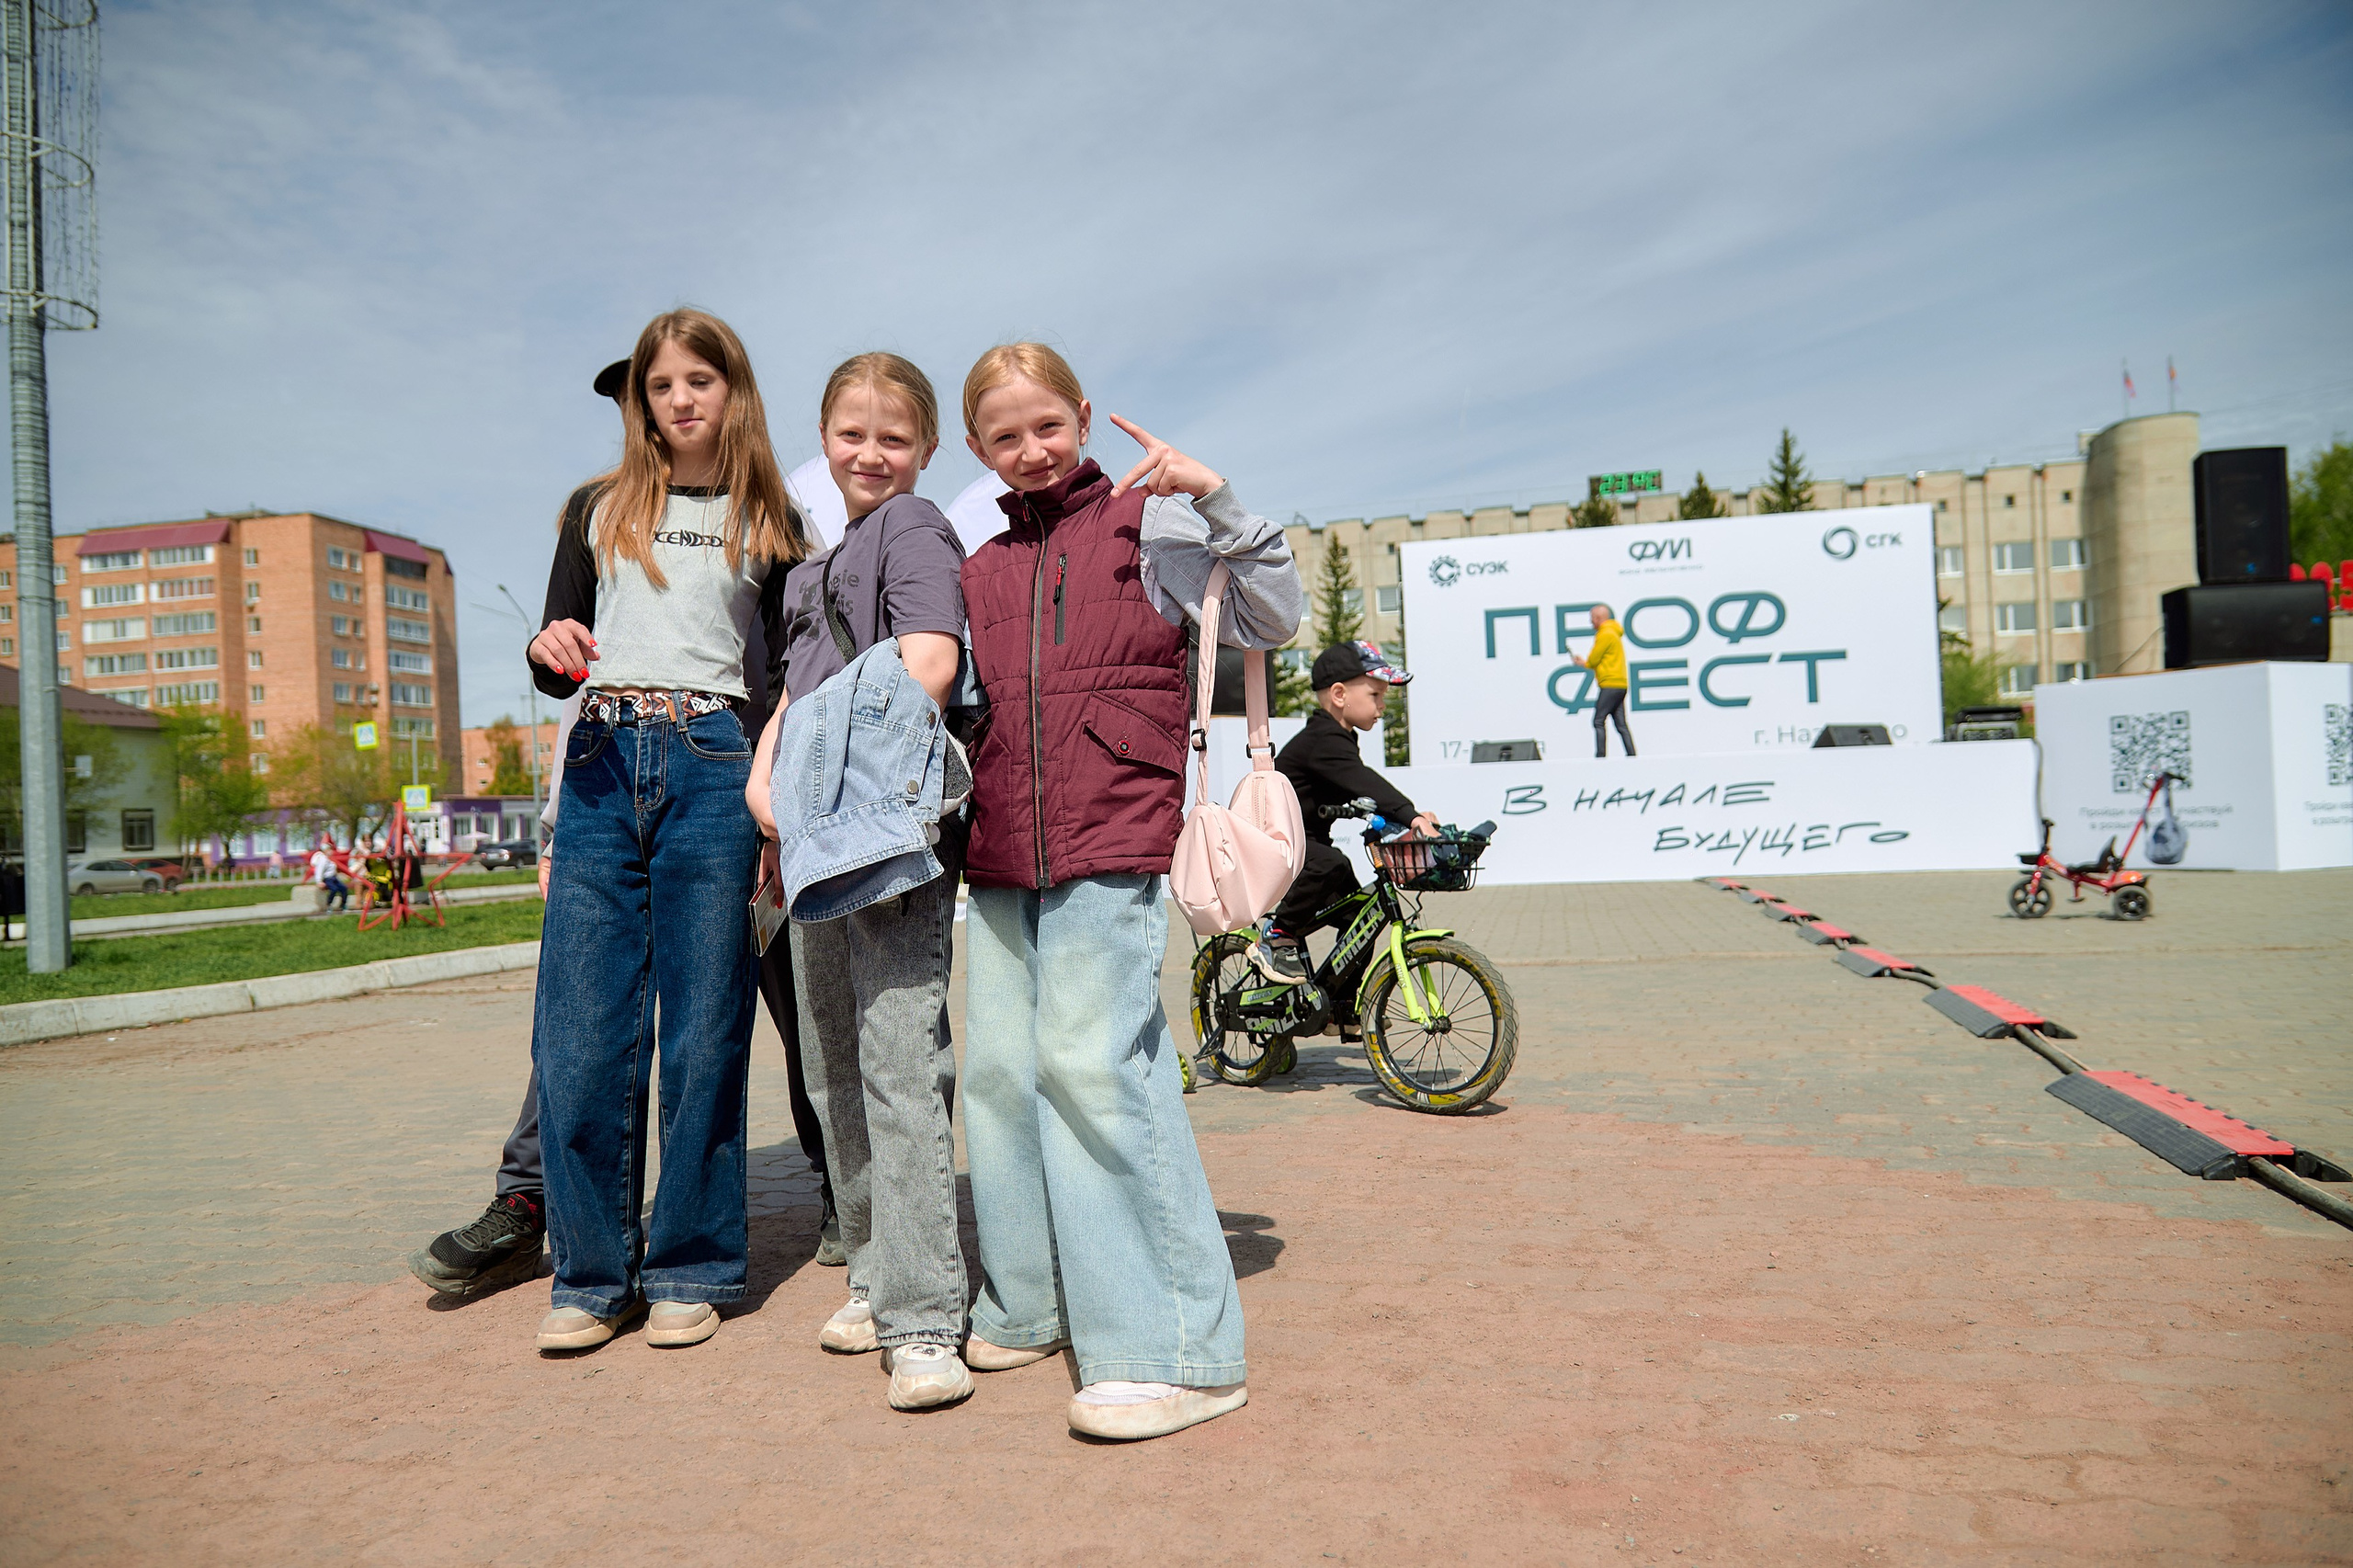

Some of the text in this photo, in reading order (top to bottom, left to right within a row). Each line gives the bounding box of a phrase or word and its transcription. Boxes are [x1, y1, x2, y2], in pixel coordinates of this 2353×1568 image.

[1599, 472, 1629, 495] 23
[1466, 560, 1508, 575] СУЭК
[1484, 591, 1786, 658] ПРОФ
[1547, 650, 1847, 714] ФЕСТ
[1501, 781, 1775, 815] В НАЧАЛЕ
[1653, 823, 1911, 866] БУДУЩЕГО
